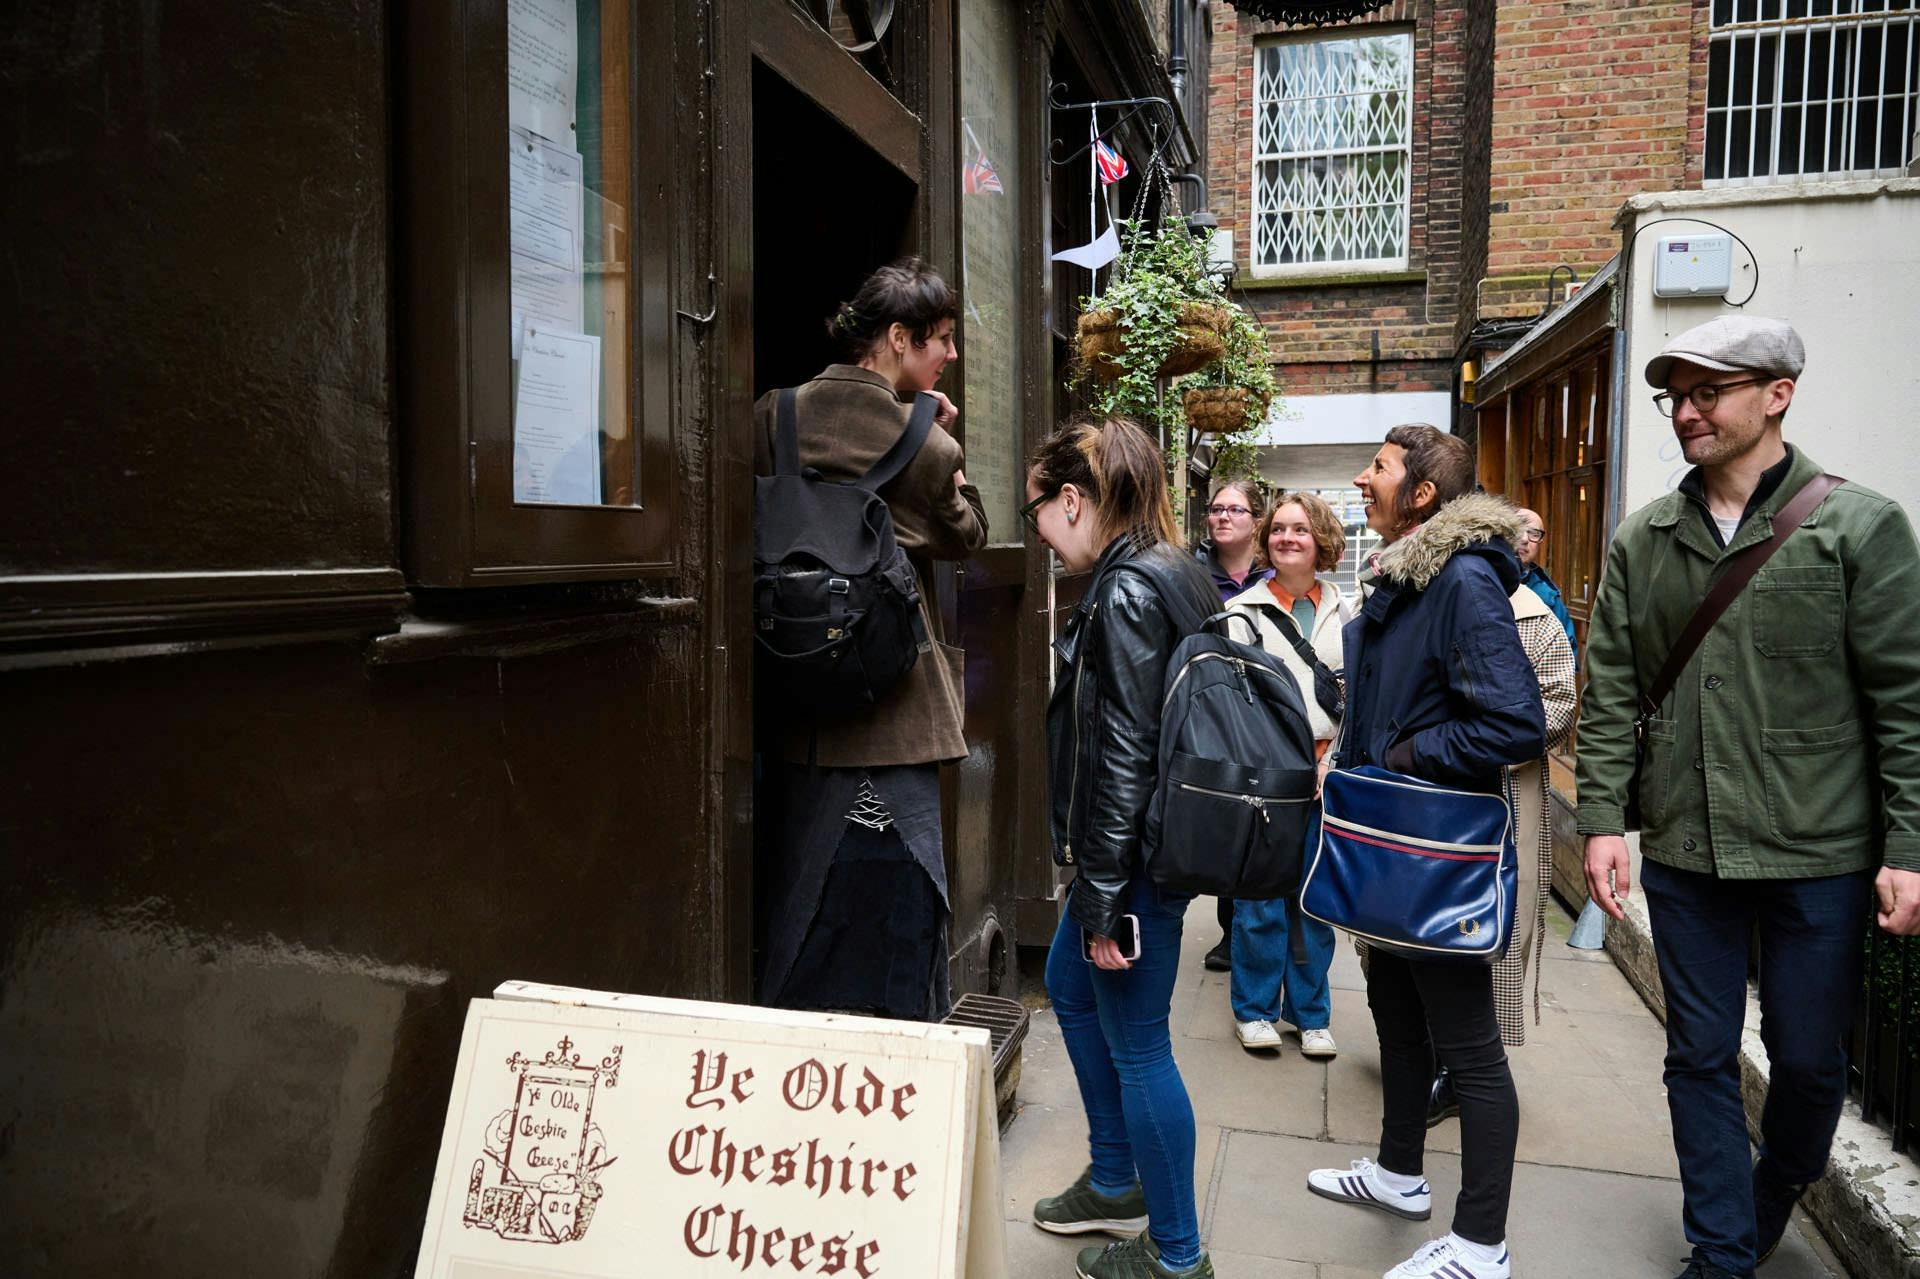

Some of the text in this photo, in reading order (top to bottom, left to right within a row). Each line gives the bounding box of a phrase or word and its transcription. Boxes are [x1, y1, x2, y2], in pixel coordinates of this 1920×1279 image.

[551, 1090, 580, 1112] Olde
[686, 1049, 917, 1121] Ye Olde
[519, 1115, 567, 1140] Cheshire
[668, 1124, 917, 1202] Cheshire
[684, 1203, 880, 1279] Cheese
